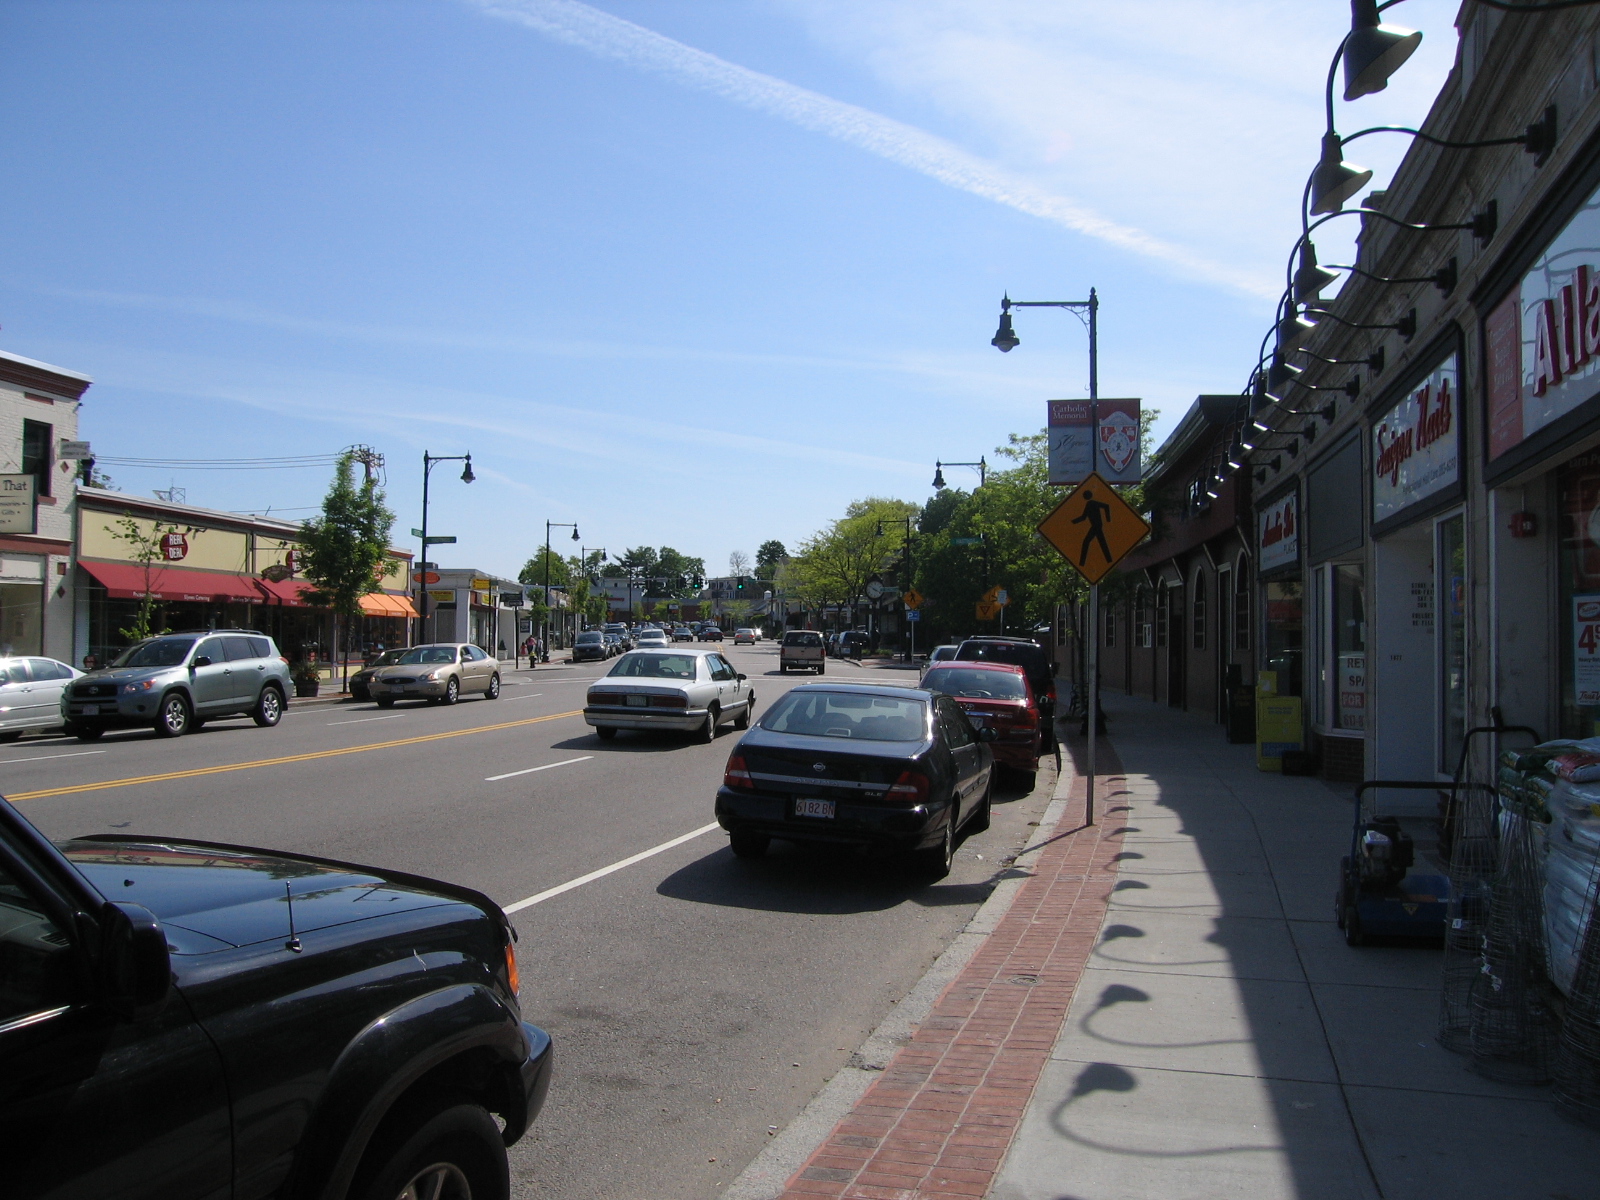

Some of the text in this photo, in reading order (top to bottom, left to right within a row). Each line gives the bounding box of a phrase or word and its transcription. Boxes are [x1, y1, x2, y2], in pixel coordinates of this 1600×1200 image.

[1052, 404, 1087, 413] Catholic
[1052, 412, 1087, 420] Memorial
[1376, 423, 1413, 487] Saigon
[1415, 377, 1452, 451] Nails
[2, 479, 28, 491] That
[168, 534, 183, 546] REAL
[168, 547, 183, 559] DEAL
[1342, 694, 1362, 707] FOR
[796, 802, 820, 814] 6182
